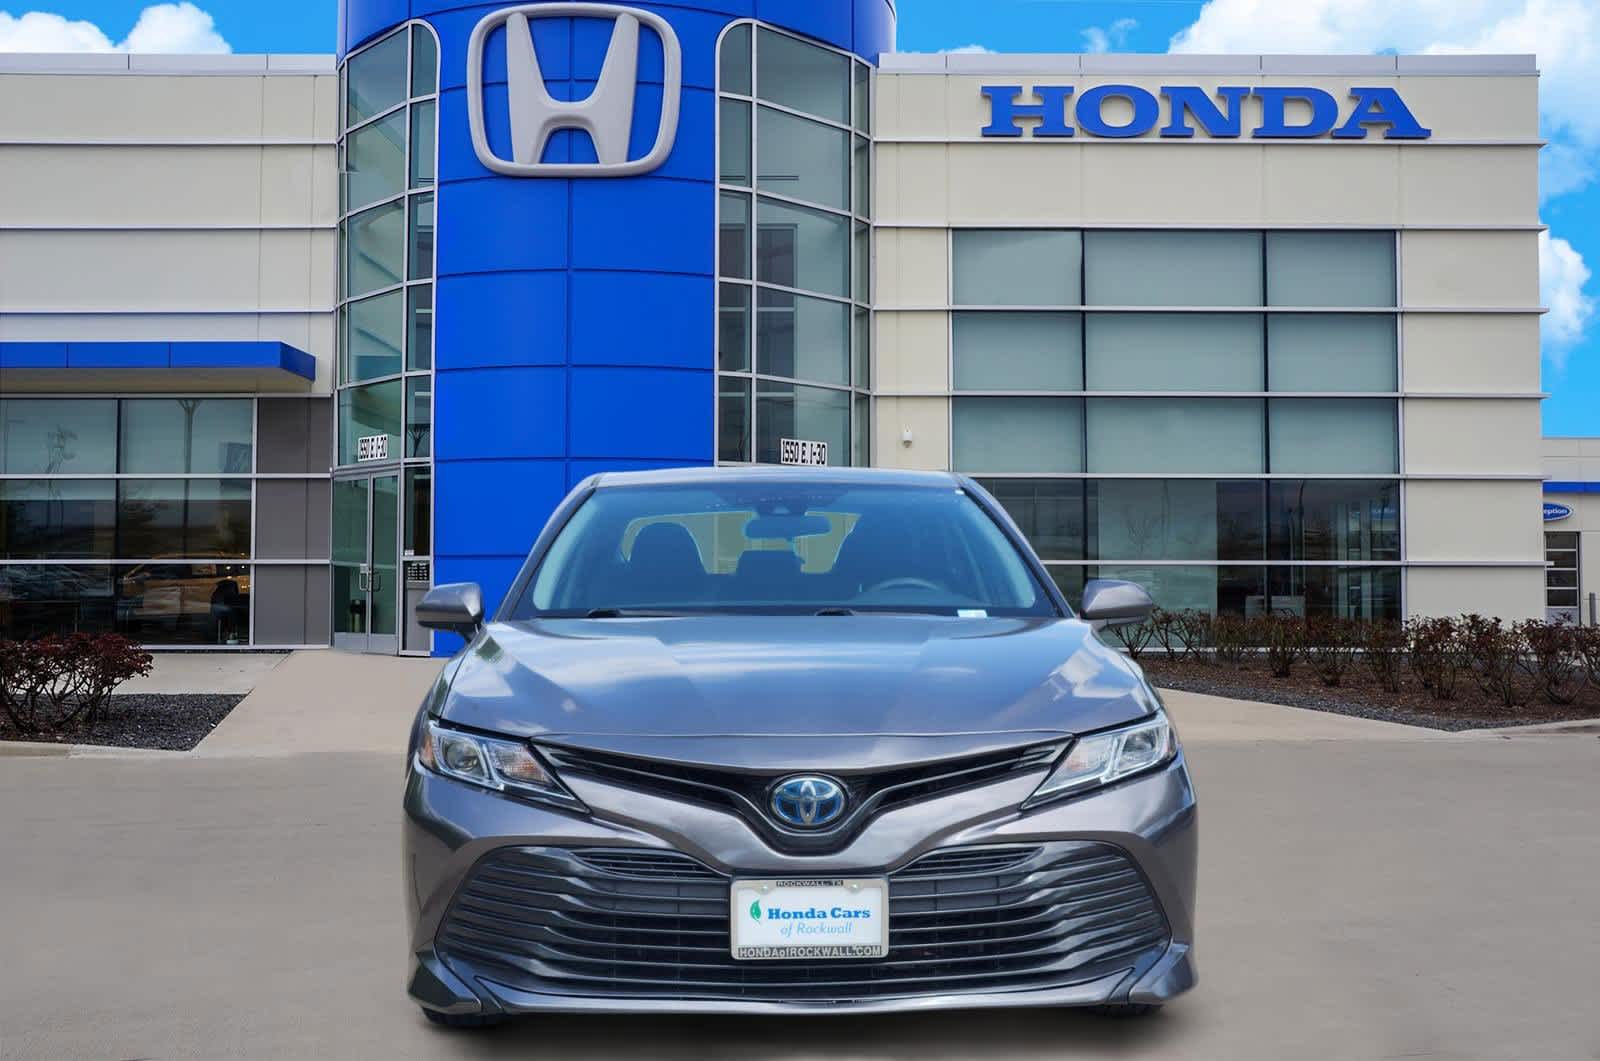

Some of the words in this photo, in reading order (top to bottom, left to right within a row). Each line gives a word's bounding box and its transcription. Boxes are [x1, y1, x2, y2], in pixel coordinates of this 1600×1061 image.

[980, 84, 1432, 139] HONDA
[782, 440, 800, 463] 1550
[810, 443, 826, 465] I-30
[767, 907, 827, 920] Honda
[830, 906, 871, 919] Cars
[780, 923, 794, 937] of
[796, 922, 853, 935] Rockwall
